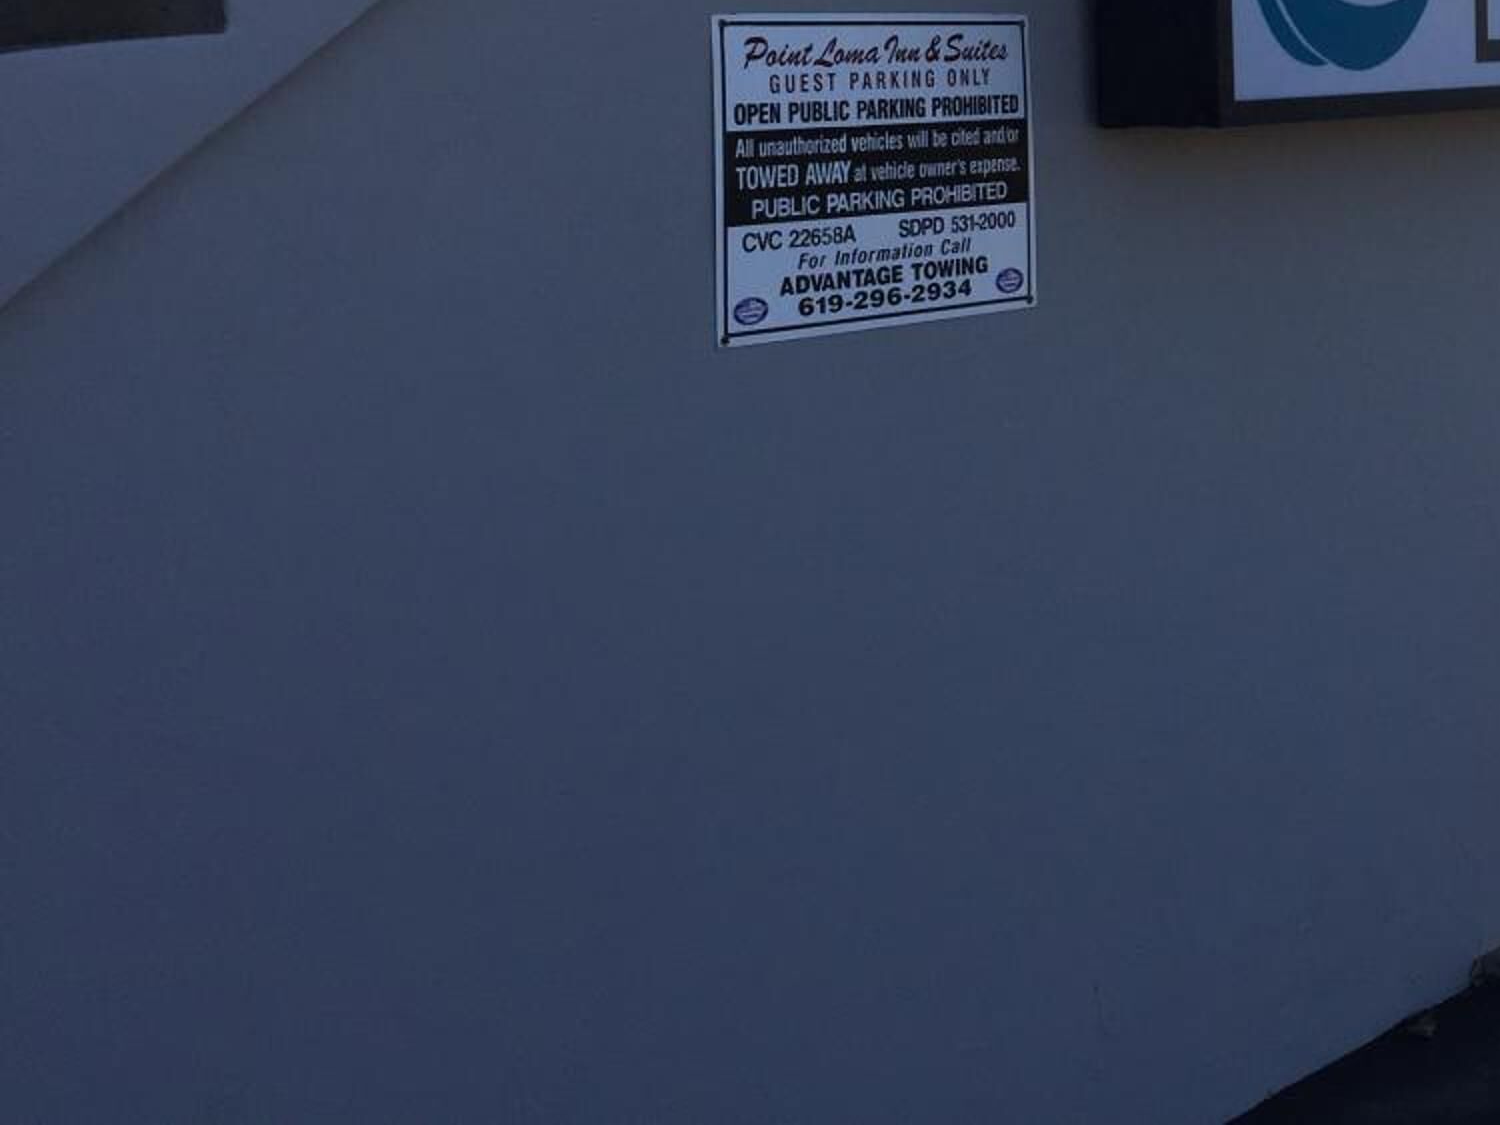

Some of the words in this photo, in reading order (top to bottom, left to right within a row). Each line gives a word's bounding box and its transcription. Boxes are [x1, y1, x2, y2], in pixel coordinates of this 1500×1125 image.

[744, 36, 813, 69] Point
[814, 37, 881, 67] Loma
[884, 35, 920, 65] Inn
[923, 37, 941, 61] &
[943, 33, 1008, 61] Suites
[769, 72, 836, 94] GUEST
[850, 69, 936, 91] PARKING
[948, 67, 991, 87] ONLY
[734, 102, 781, 125] OPEN
[788, 100, 850, 124] PUBLIC
[857, 97, 926, 120] PARKING
[932, 93, 1019, 117] PROHIBITED
[735, 138, 755, 158] All
[759, 133, 847, 157] unauthorized
[851, 130, 903, 152] vehicles
[907, 129, 929, 149] will
[932, 128, 948, 147] be
[951, 127, 980, 147] cited
[983, 125, 1020, 144] and/or
[736, 165, 799, 190] TOWED
[805, 160, 852, 186] AWAY
[854, 165, 867, 182] at
[871, 161, 915, 181] vehicle
[919, 158, 966, 177] owner's
[969, 158, 1021, 178] expense.
[751, 196, 820, 220] PUBLIC
[827, 189, 905, 214] PARKING
[911, 181, 1007, 207] PROHIBITED
[742, 232, 783, 253] CVC
[789, 225, 857, 249] 22658A
[899, 217, 945, 238] SDPD
[951, 211, 1016, 232] 531-2000
[798, 251, 827, 271] For
[835, 242, 933, 268] Information
[940, 238, 971, 255] Call
[780, 265, 904, 297] ADVANTAGE
[912, 256, 989, 280] TOWING
[798, 279, 972, 316] 619-296-2934
